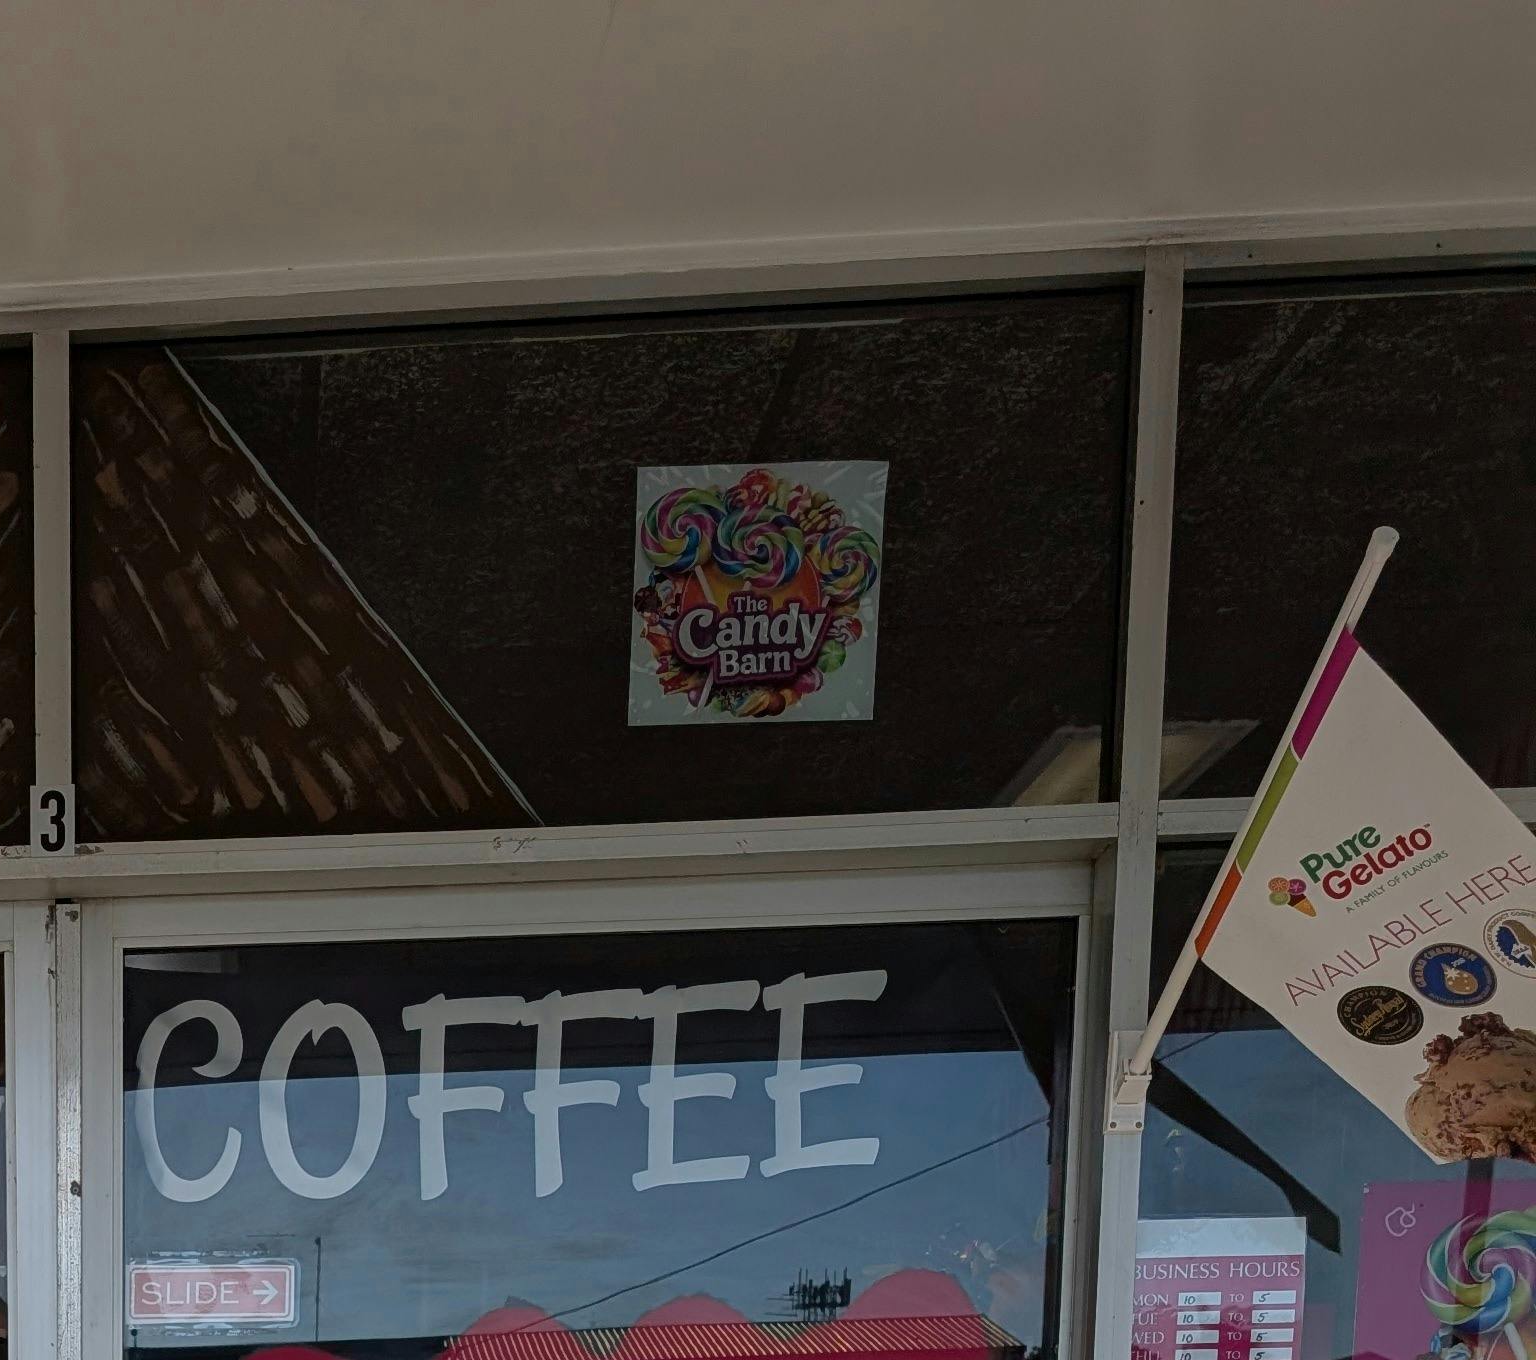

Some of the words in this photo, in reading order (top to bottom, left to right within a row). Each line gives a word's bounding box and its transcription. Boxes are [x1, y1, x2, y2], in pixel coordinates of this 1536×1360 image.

[734, 596, 768, 614] The
[678, 603, 826, 659] Candy
[718, 649, 791, 678] Barn
[40, 790, 65, 852] 3
[1299, 825, 1381, 885] Pure
[1322, 827, 1432, 899] Gelato
[1345, 905, 1354, 914] A
[1354, 885, 1386, 910] FAMILY
[1387, 875, 1402, 888] OF
[1402, 850, 1449, 880] FLAVOURS
[1285, 899, 1453, 1006] AVAILABLE
[1445, 854, 1536, 914] HERE
[135, 969, 888, 1203] COFFEE
[1135, 1263, 1219, 1280] BUSINESS
[1229, 1261, 1300, 1278] HOURS
[142, 1281, 239, 1305] SLIDE
[1133, 1294, 1168, 1306] MON
[1184, 1296, 1196, 1304] 10
[1229, 1293, 1244, 1302] TO
[1258, 1293, 1270, 1302] 5
[1183, 1314, 1194, 1323] 10
[1228, 1312, 1243, 1321] TO
[1257, 1312, 1269, 1322] 5
[1181, 1333, 1193, 1342] 10
[1227, 1332, 1242, 1340] TO
[1180, 1353, 1191, 1360] 10
[1226, 1351, 1241, 1359] TO
[1254, 1351, 1265, 1360] 5
